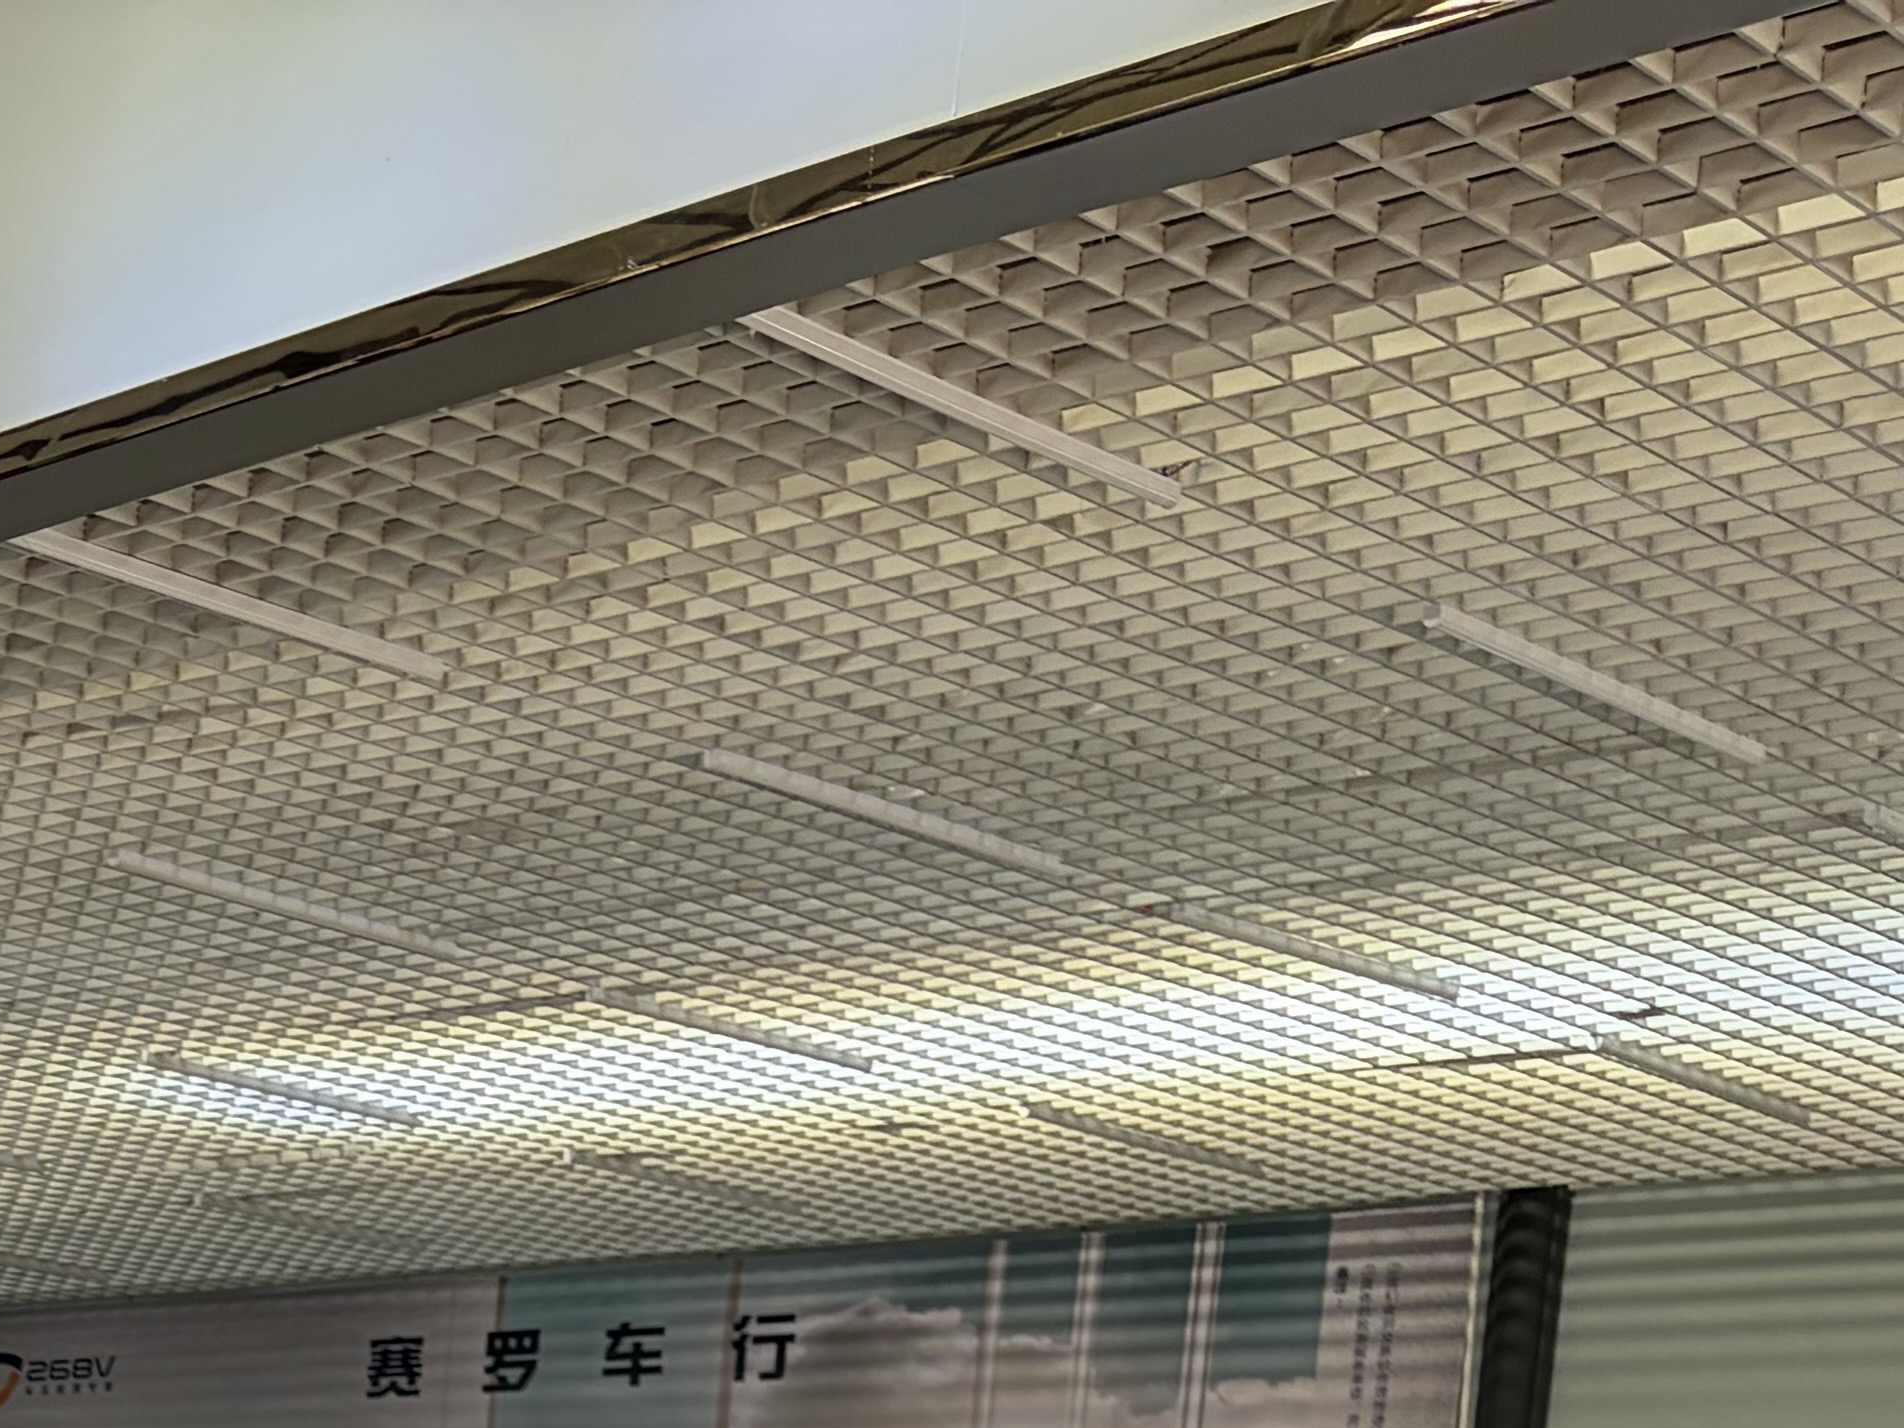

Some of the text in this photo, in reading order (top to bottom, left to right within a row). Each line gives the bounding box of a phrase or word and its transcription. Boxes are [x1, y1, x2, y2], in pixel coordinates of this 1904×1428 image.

[25, 1354, 116, 1382] 268V
[366, 1314, 796, 1398] 赛罗车行
